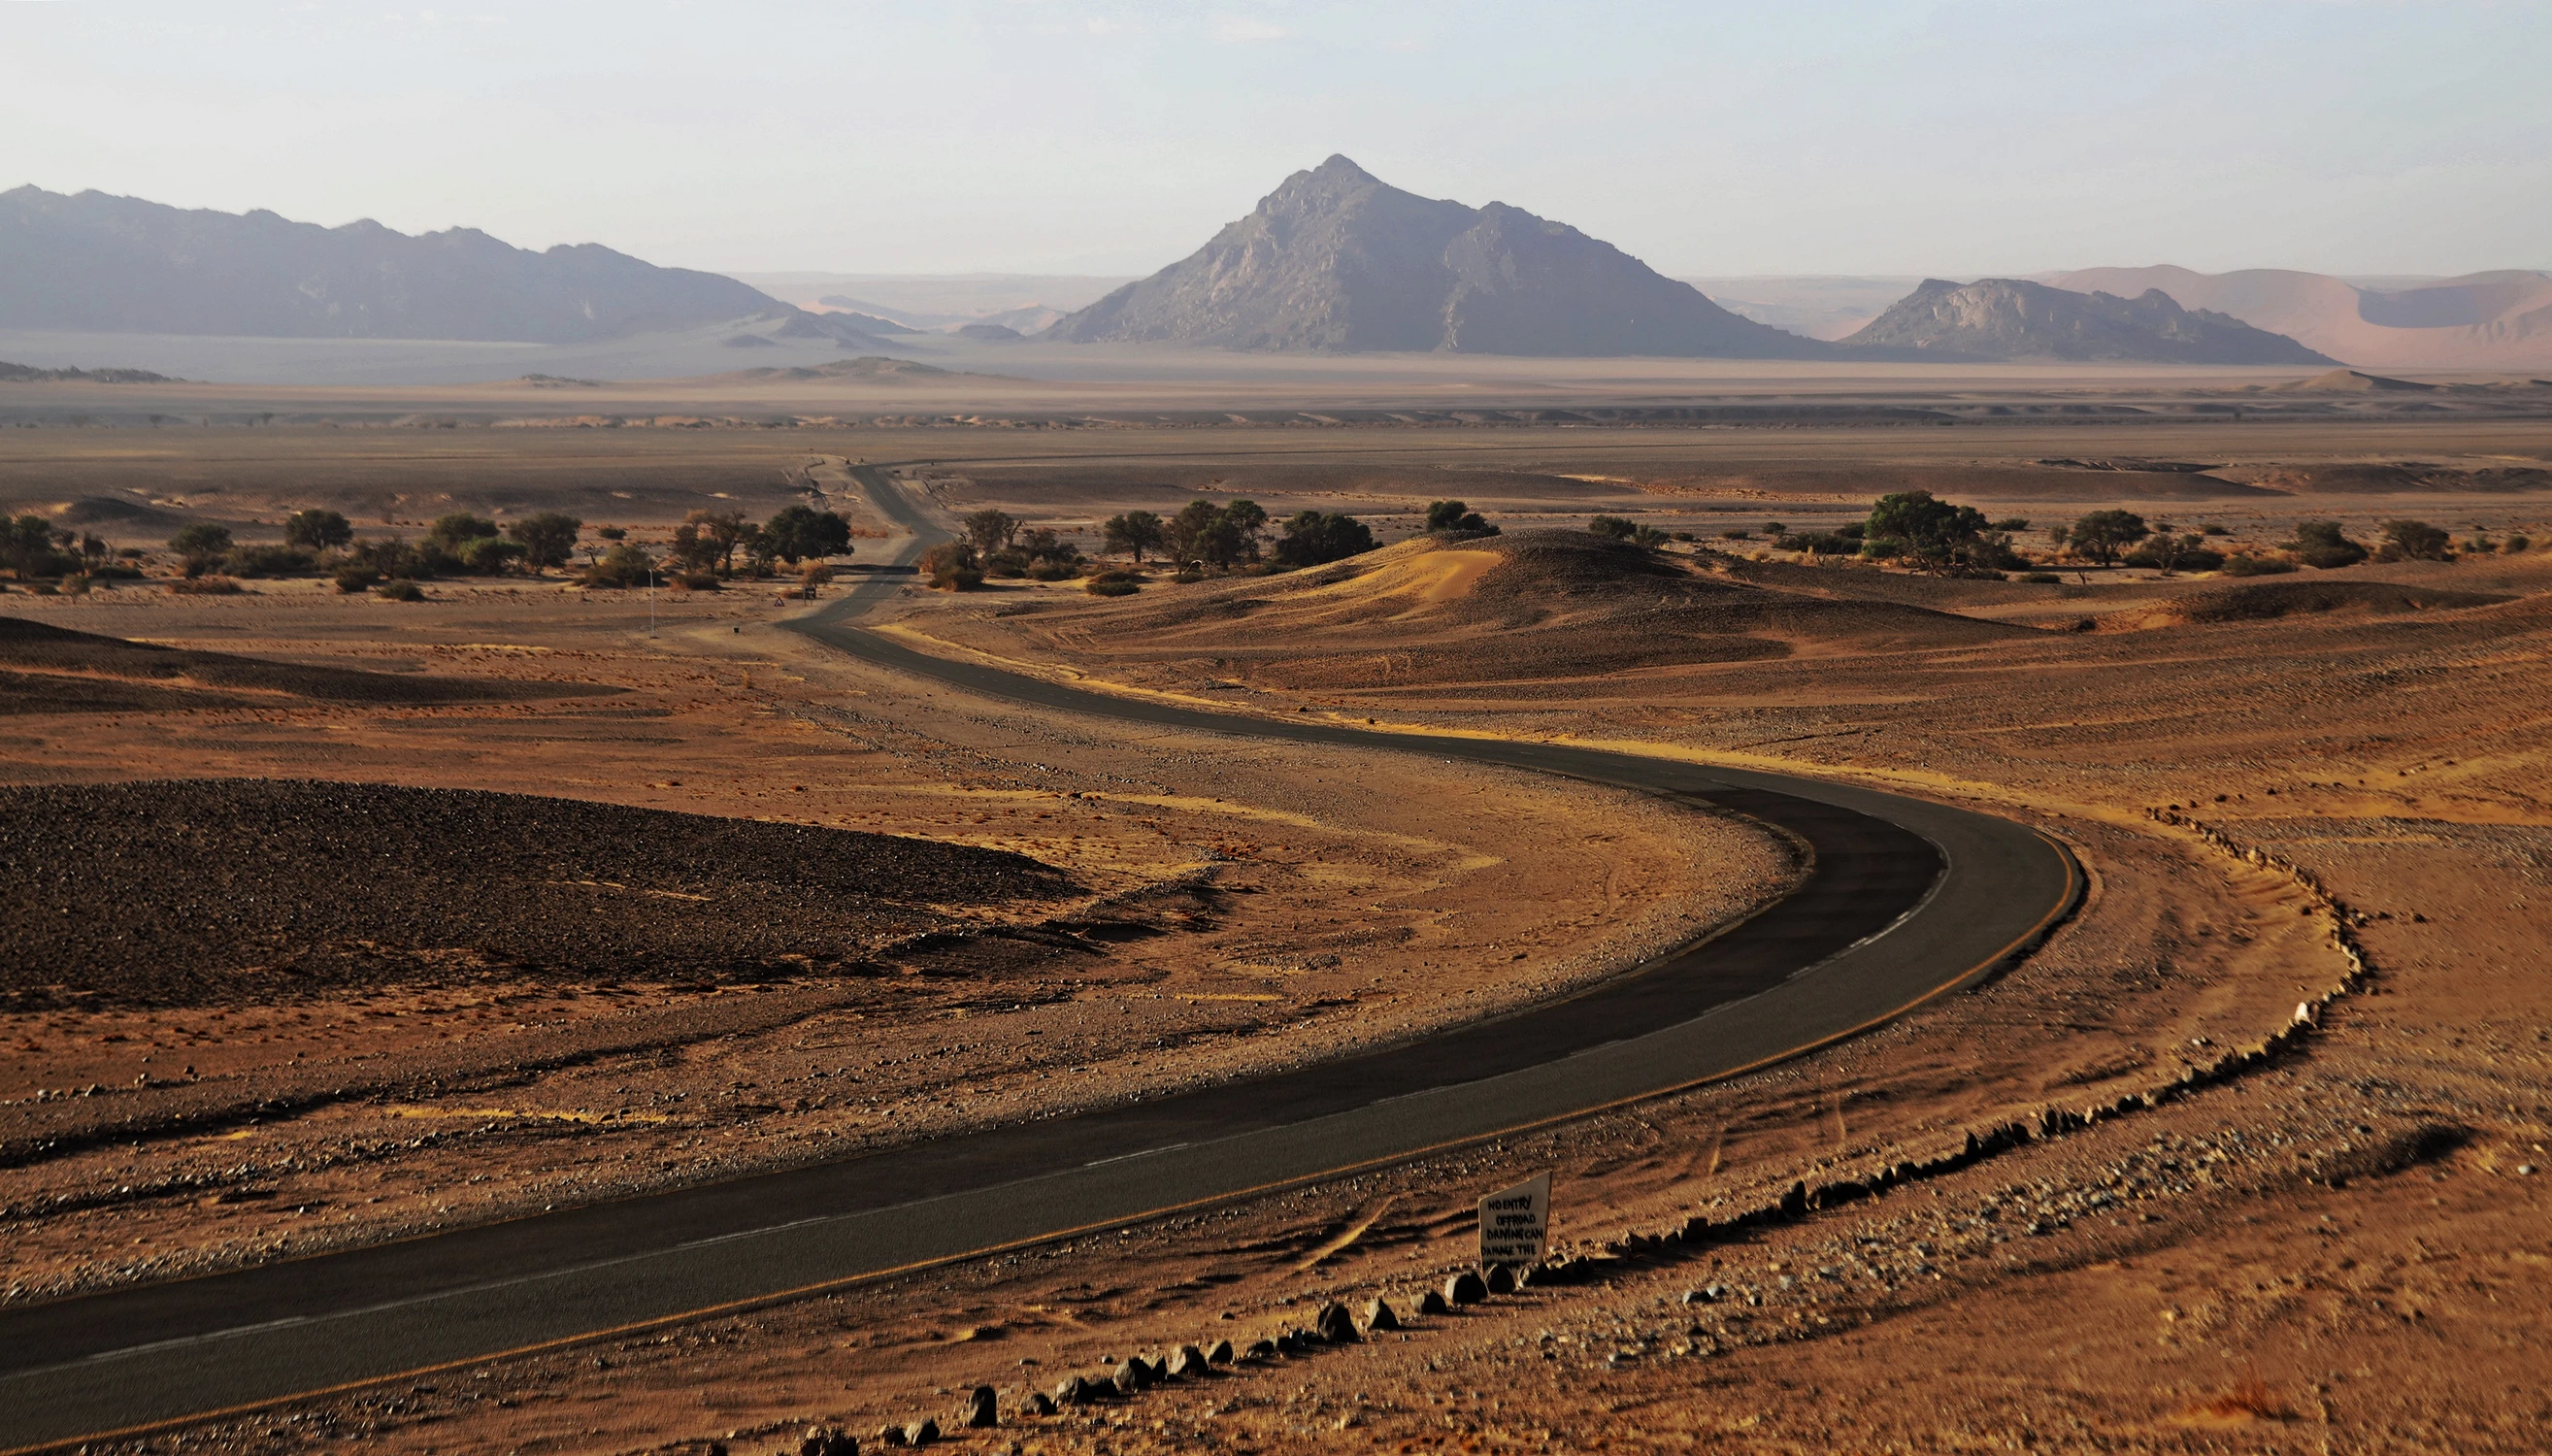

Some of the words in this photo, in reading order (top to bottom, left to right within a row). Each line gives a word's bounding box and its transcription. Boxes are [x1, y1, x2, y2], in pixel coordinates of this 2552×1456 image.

[1488, 1200, 1502, 1211] NO
[1503, 1195, 1532, 1211] ENTRY
[1524, 1228, 1543, 1241] CAN
[1481, 1245, 1514, 1257] DAMAGE
[1516, 1243, 1537, 1257] THE
